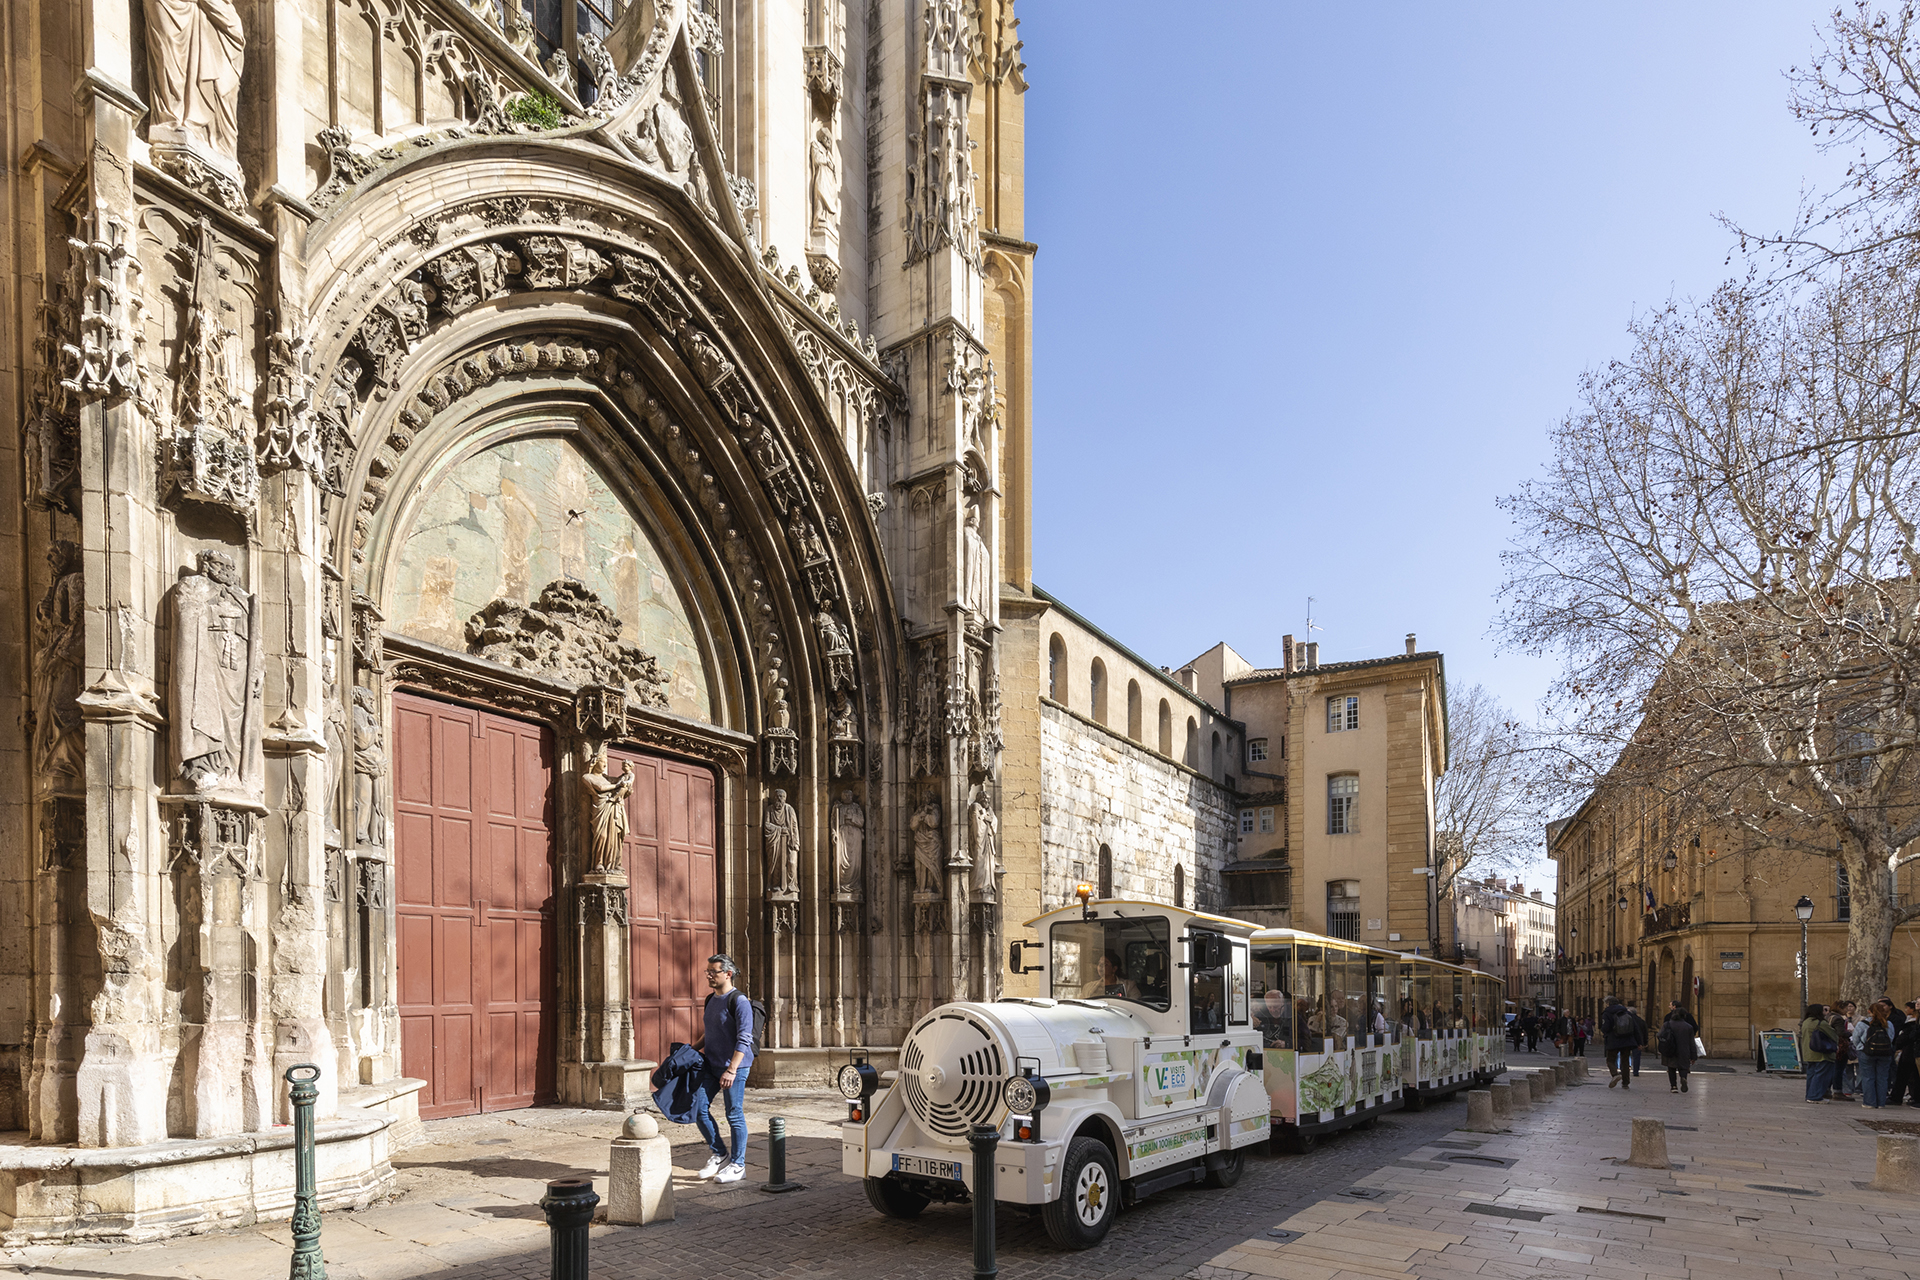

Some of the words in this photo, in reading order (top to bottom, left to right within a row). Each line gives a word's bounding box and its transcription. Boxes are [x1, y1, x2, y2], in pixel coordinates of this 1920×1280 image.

[1170, 1066, 1185, 1074] VISITE
[1171, 1073, 1186, 1085] ECO
[1140, 1141, 1158, 1154] TRAIN
[1159, 1137, 1173, 1149] 100%
